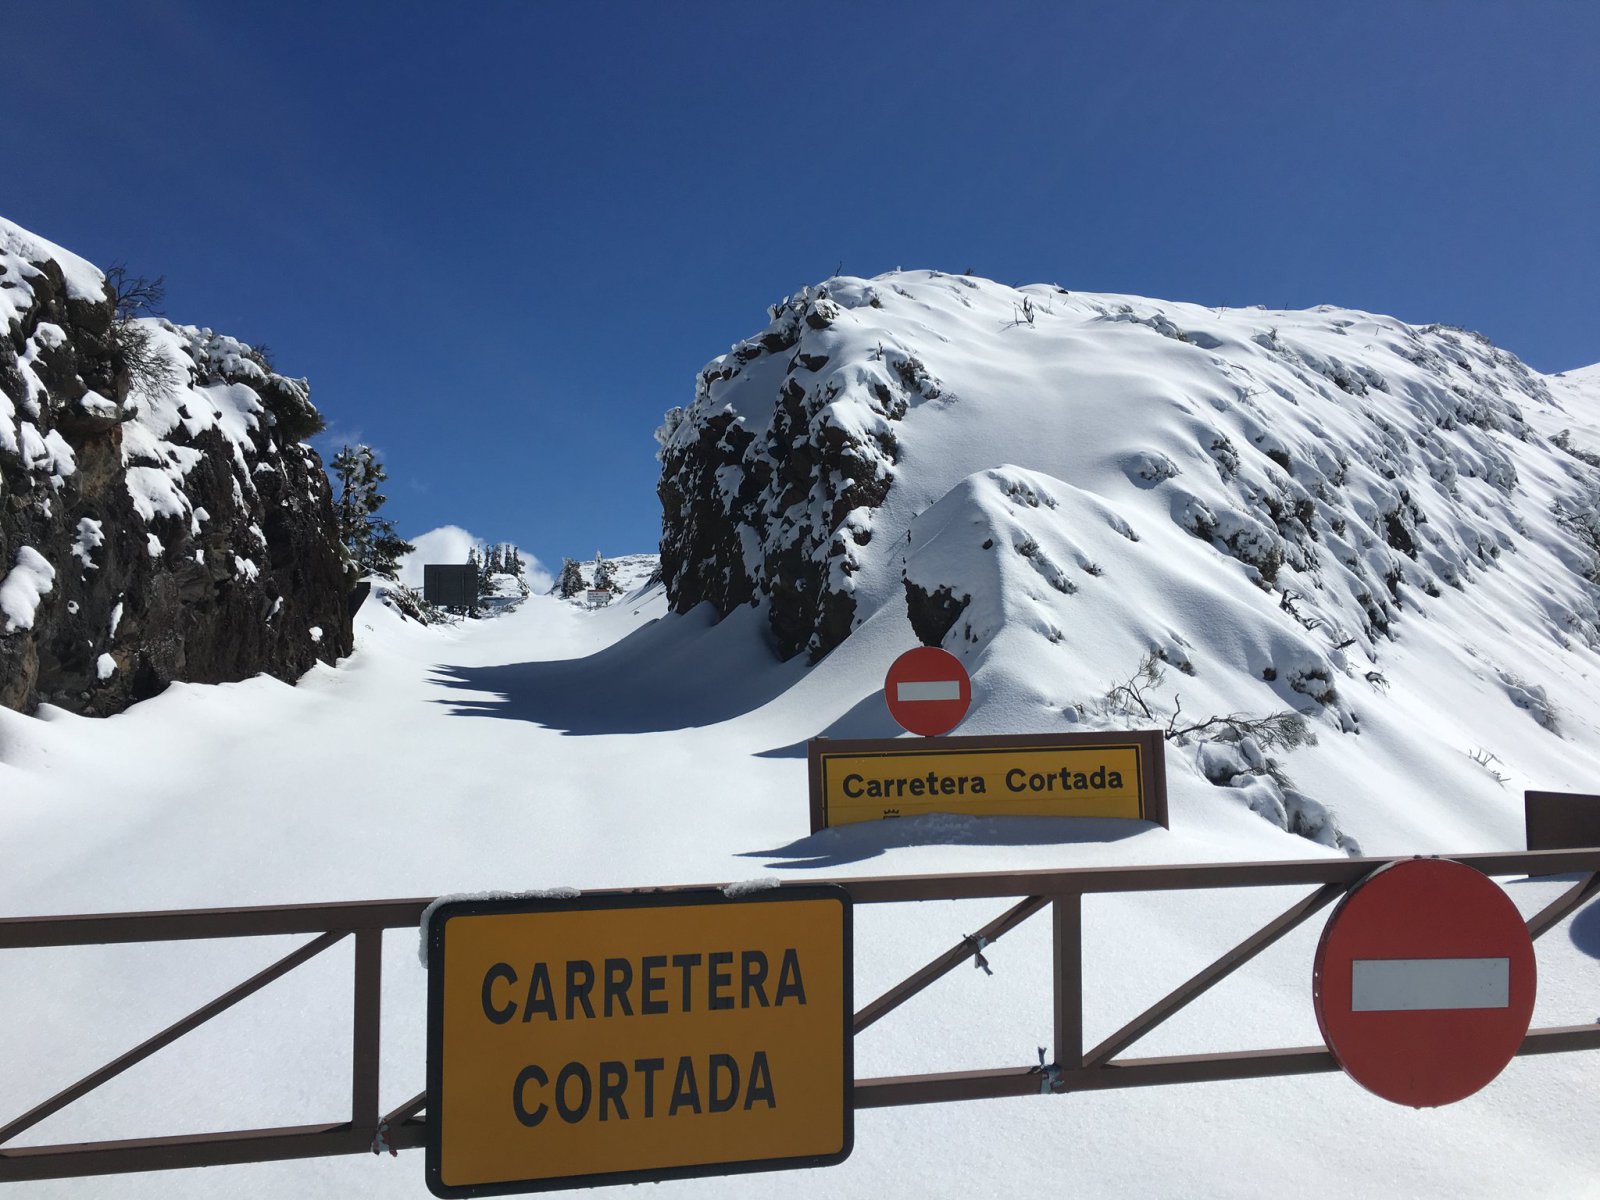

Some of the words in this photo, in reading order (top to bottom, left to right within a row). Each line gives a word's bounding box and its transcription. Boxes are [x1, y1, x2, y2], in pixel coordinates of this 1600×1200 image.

[842, 771, 987, 799] Carretera
[1005, 765, 1124, 793] Cortada
[481, 948, 807, 1025] CARRETERA
[512, 1050, 777, 1128] CORTADA
